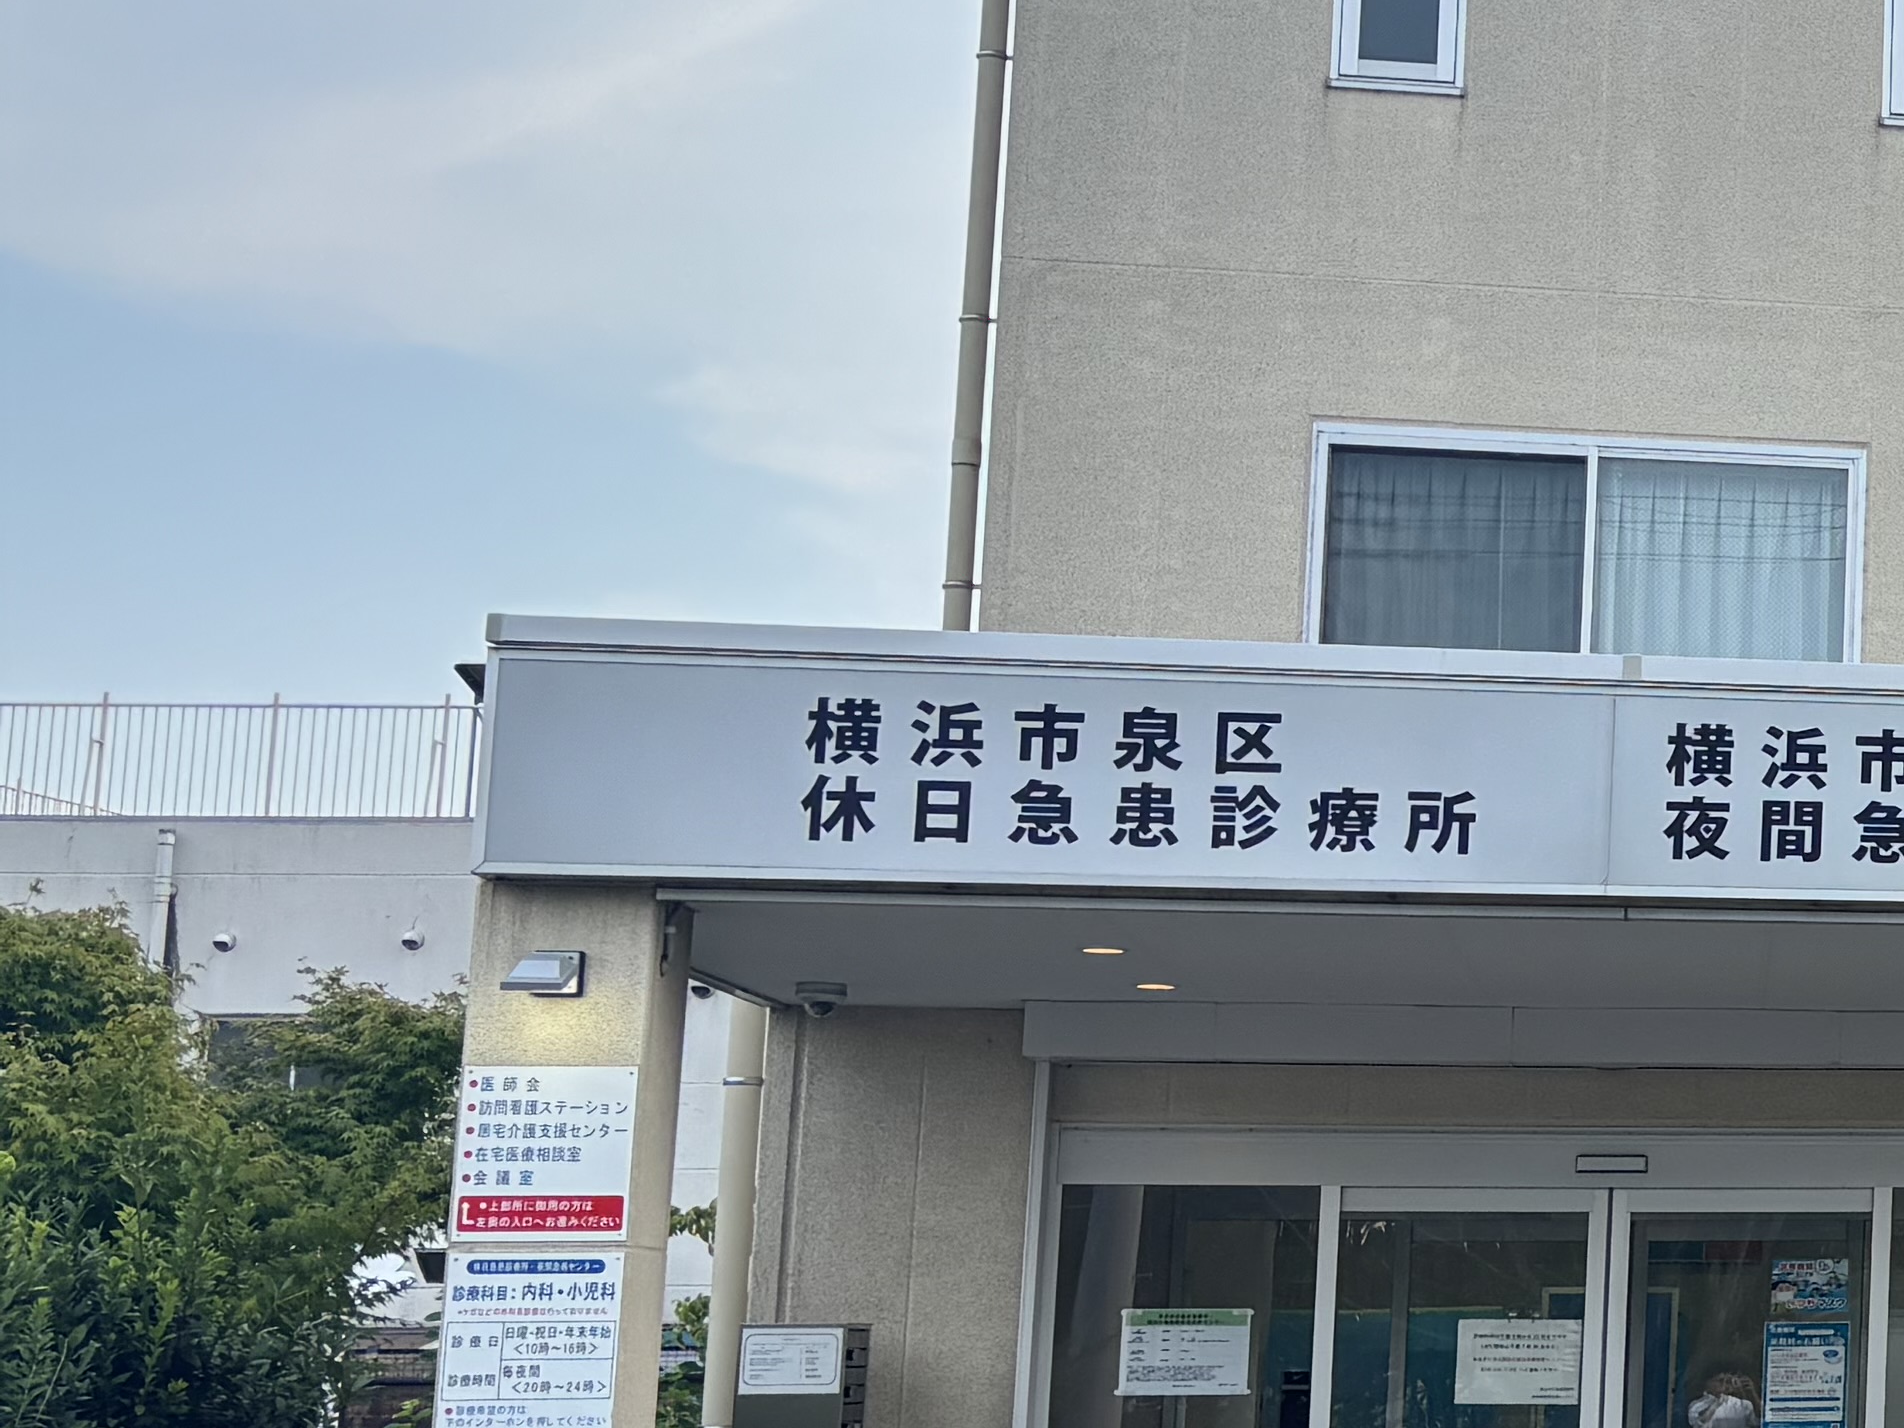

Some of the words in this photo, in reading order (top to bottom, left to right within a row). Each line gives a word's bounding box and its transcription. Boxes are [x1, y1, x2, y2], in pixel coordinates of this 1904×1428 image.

[805, 696, 1283, 776] 横浜市泉区
[801, 774, 1477, 855] 休日急患診療所
[480, 1076, 541, 1092] 医師会
[479, 1099, 629, 1116] 訪問看護ステーション
[477, 1123, 629, 1139] 居宅介護支援センター
[475, 1146, 582, 1162] 在宅医療相談室
[473, 1170, 535, 1186] 会議室
[451, 1335, 499, 1348] 診療日
[502, 1364, 541, 1379] 毎夜間
[447, 1373, 497, 1388] 診療時間
